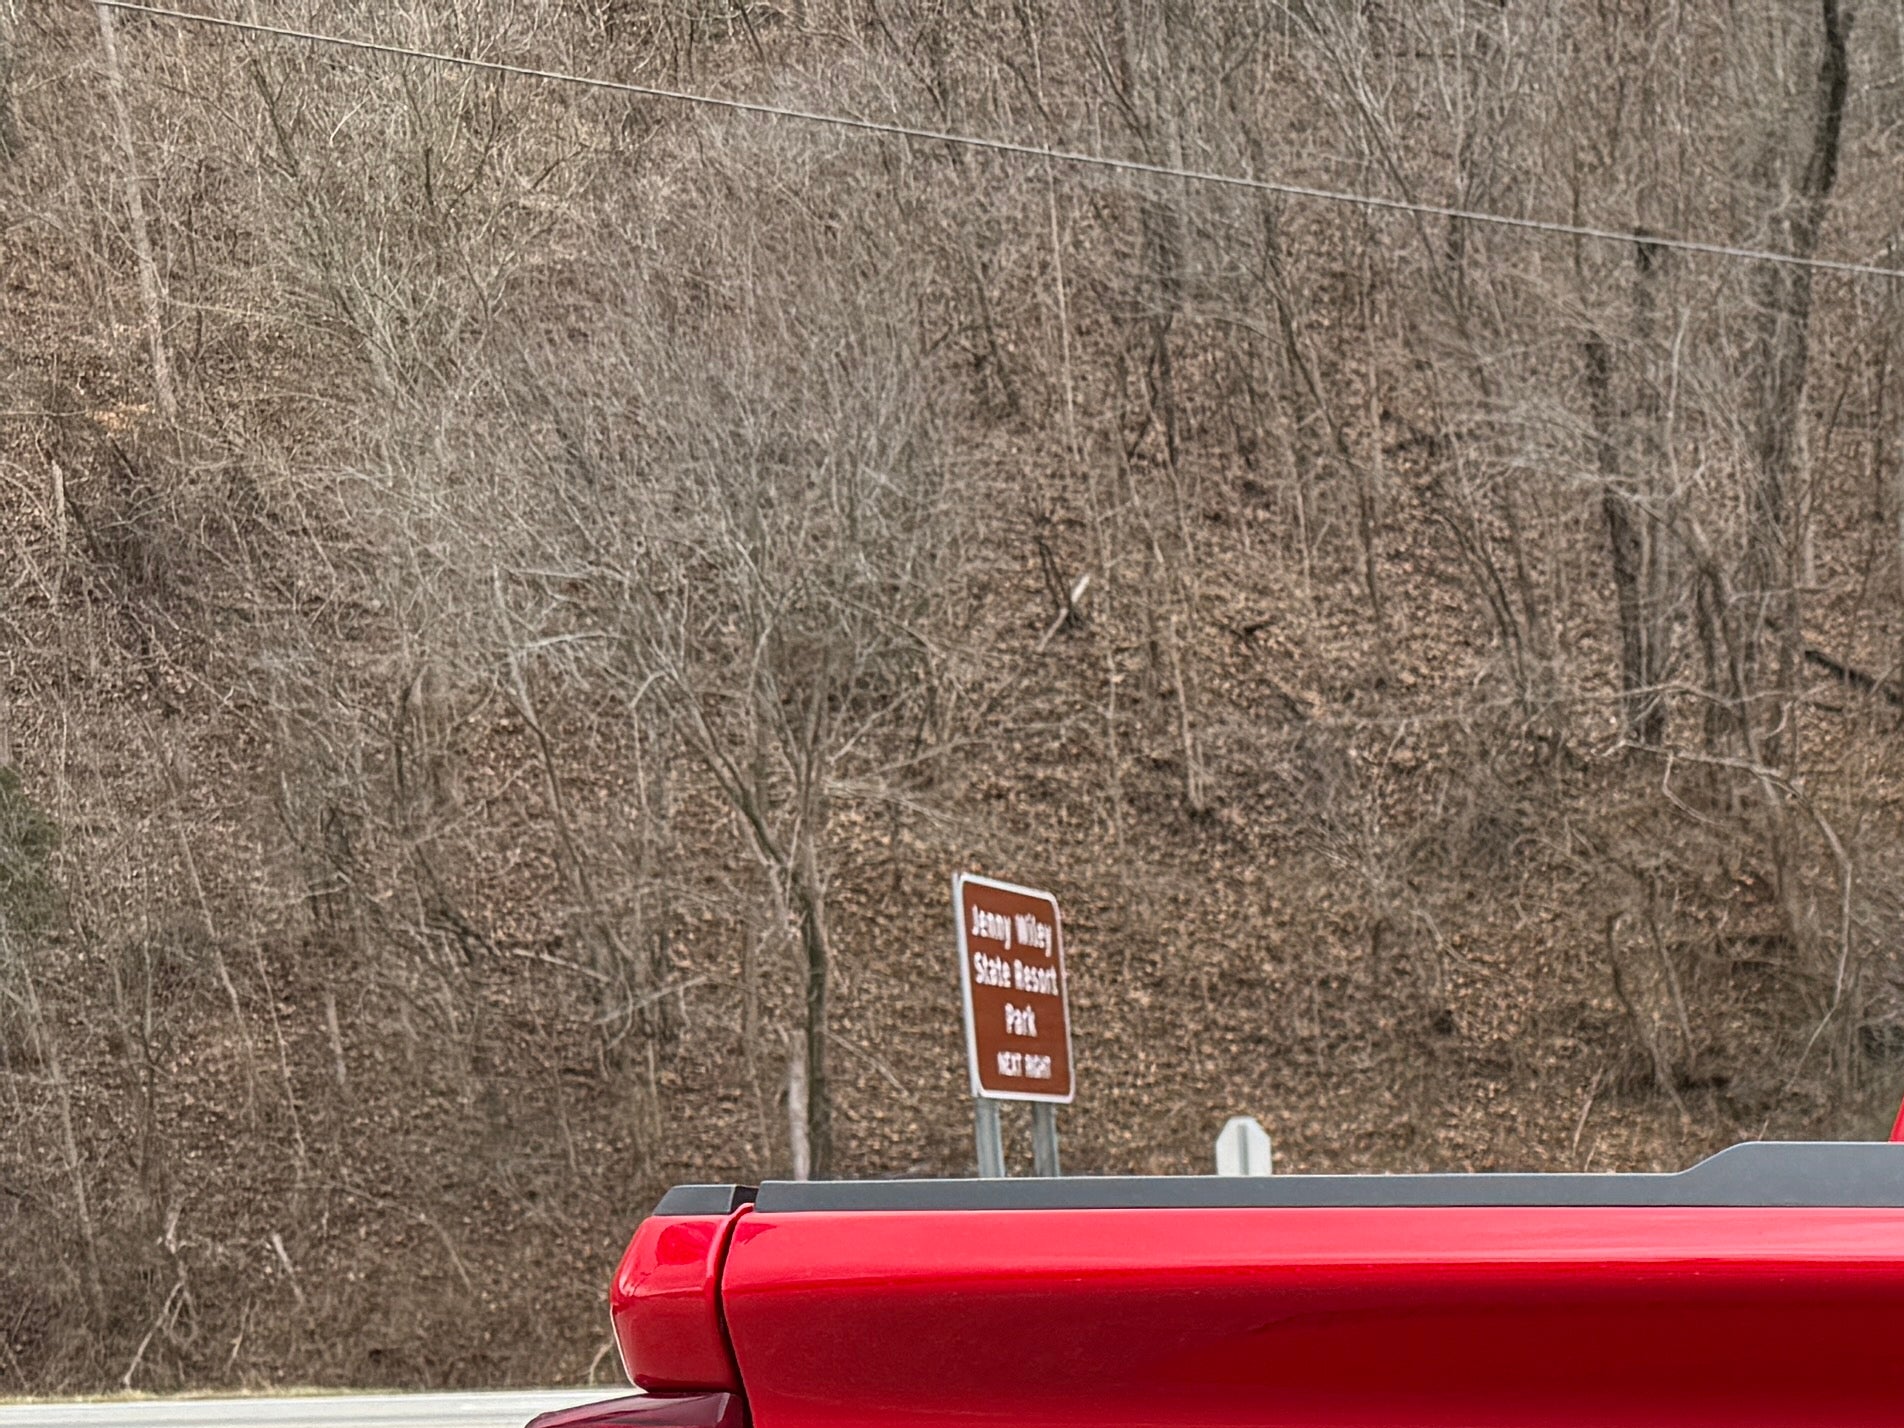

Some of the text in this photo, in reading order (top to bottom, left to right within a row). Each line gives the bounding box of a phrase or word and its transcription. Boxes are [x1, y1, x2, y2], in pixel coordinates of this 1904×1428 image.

[971, 904, 1052, 957] Jenny Wiley
[974, 951, 1058, 996] State Resort
[1004, 1002, 1037, 1037] Park
[997, 1051, 1022, 1077] NEXT
